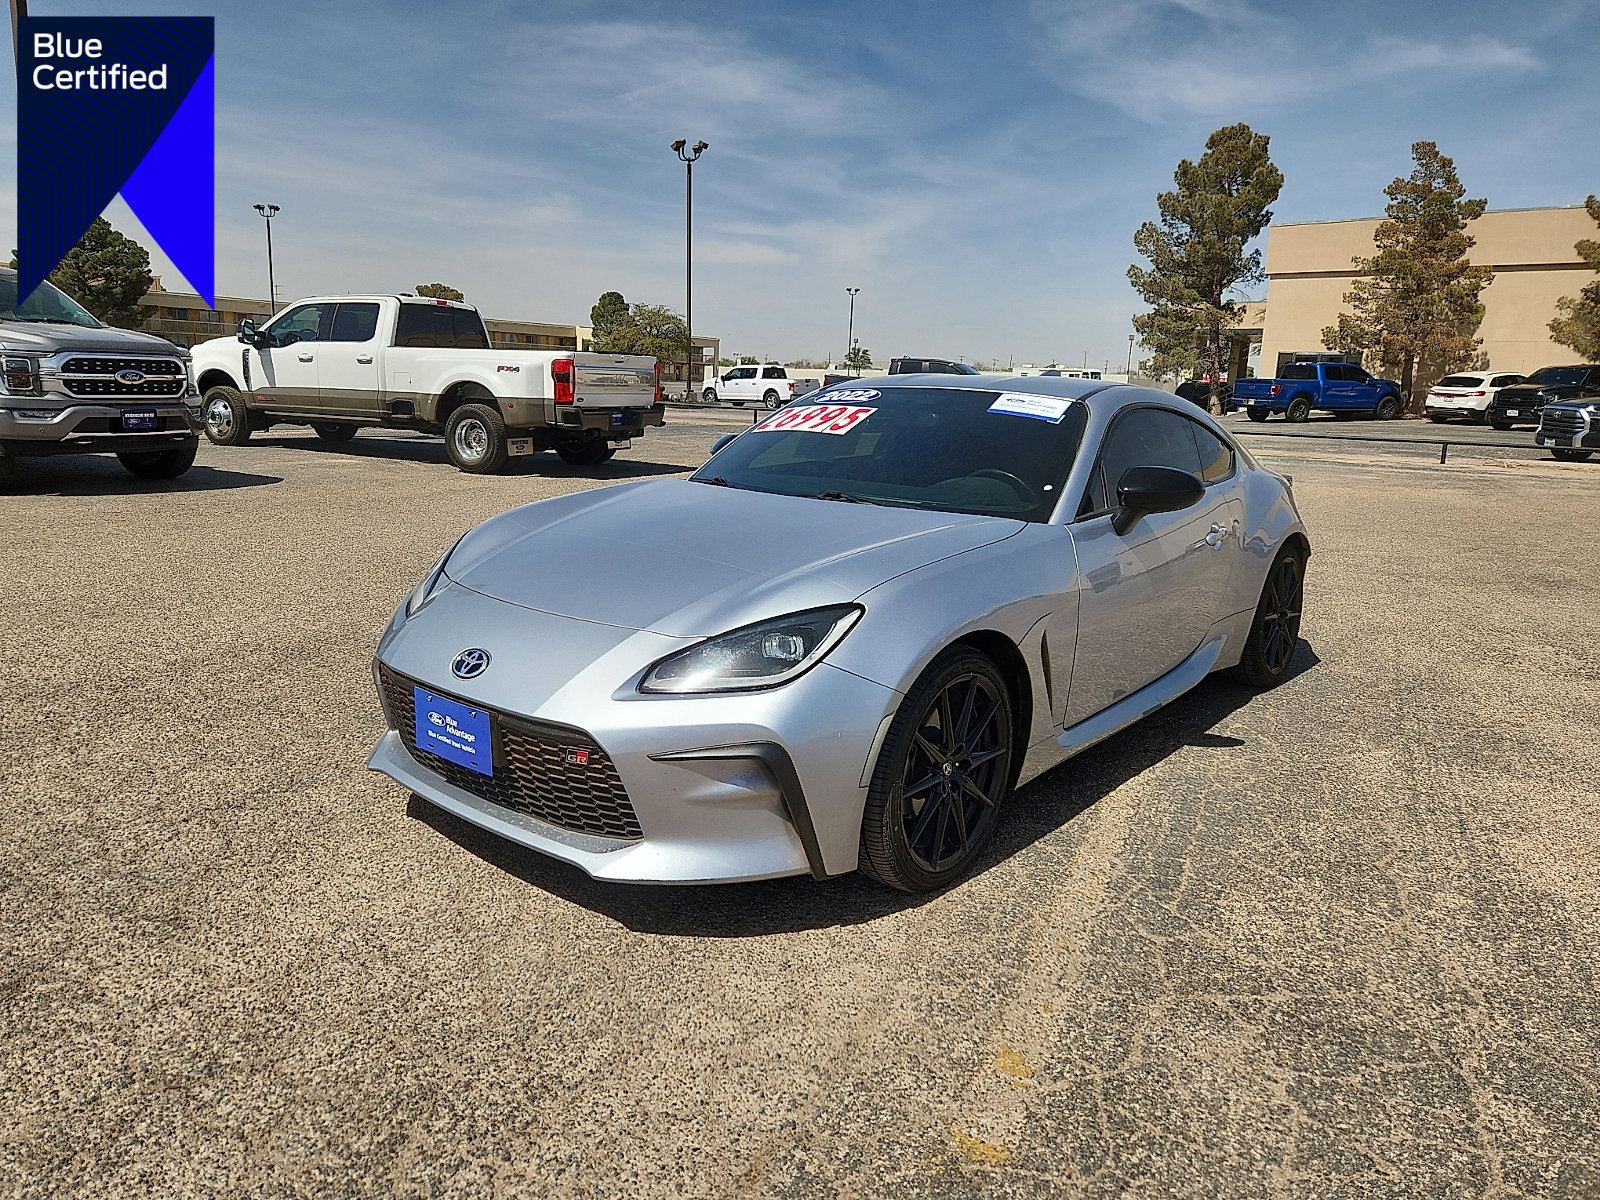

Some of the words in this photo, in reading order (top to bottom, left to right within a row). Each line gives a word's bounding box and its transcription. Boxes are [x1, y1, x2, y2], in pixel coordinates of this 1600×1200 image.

[497, 365, 520, 373] FX4
[823, 389, 872, 401] 2022
[756, 406, 872, 431] 26995
[445, 715, 458, 728] Blue
[446, 725, 476, 743] Advantage
[567, 754, 587, 764] GR
